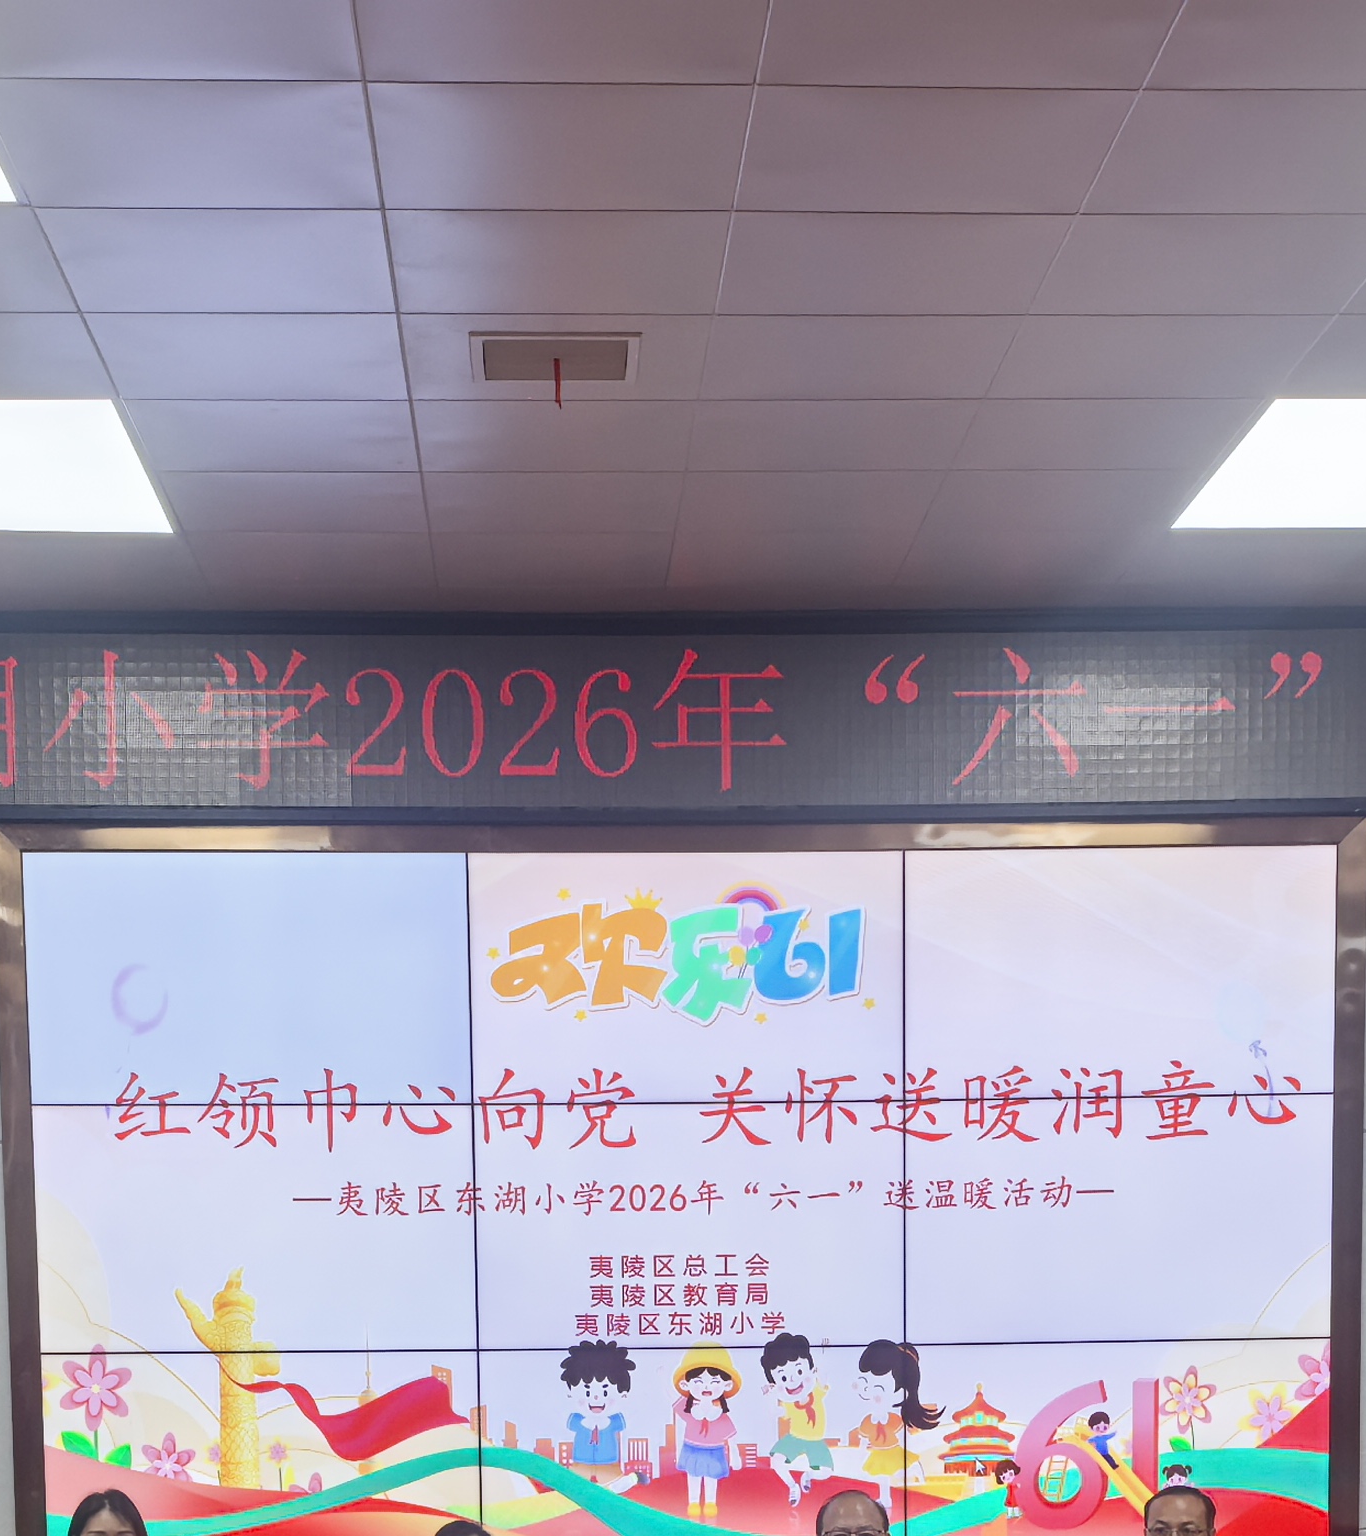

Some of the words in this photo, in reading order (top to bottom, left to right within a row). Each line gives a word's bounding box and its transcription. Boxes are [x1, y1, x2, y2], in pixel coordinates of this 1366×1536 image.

[114, 1066, 639, 1153] 红领巾心向党
[699, 1060, 1304, 1148] 关怀送暖润童心
[589, 1253, 770, 1279] 夷陵区总工会
[589, 1282, 769, 1308] 夷陵区教育局
[574, 1311, 786, 1337] 夷陵区东湖小学
